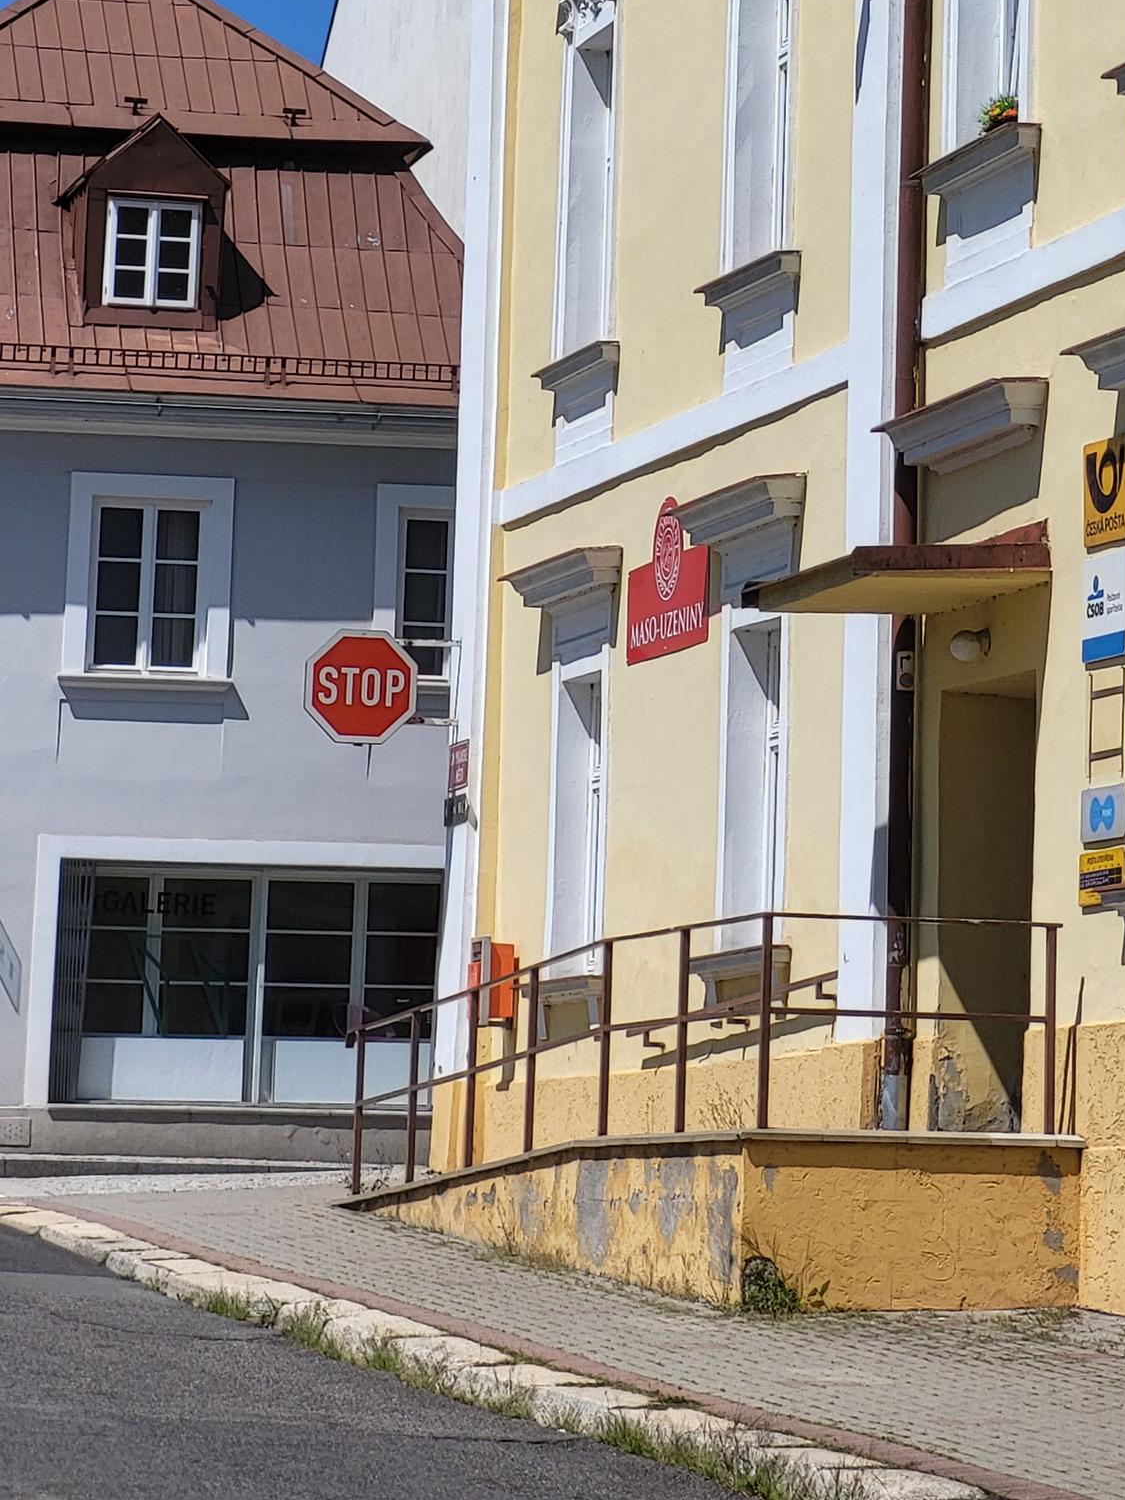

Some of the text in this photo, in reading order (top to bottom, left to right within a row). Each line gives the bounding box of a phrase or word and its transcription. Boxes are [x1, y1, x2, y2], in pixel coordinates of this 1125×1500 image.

[1085, 512, 1125, 537] ČESKÁ POŠTA
[630, 601, 704, 649] MASO-UZENINY
[1087, 601, 1104, 619] ČSOB
[318, 666, 405, 707] STOP
